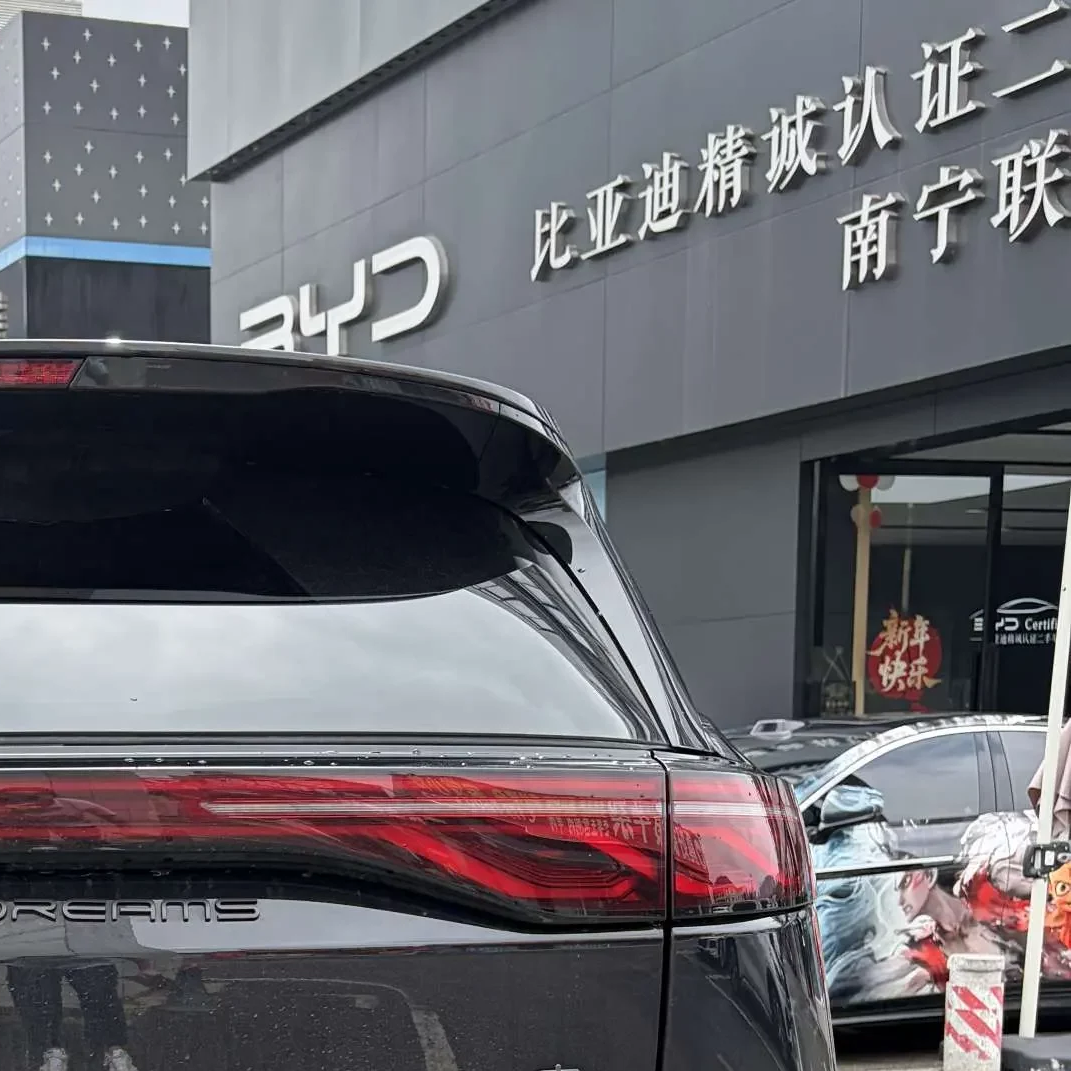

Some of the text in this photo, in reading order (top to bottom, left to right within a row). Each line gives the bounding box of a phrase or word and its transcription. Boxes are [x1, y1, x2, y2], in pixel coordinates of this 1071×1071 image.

[836, 128, 1071, 291] 南宁联
[239, 234, 449, 356] BYD
